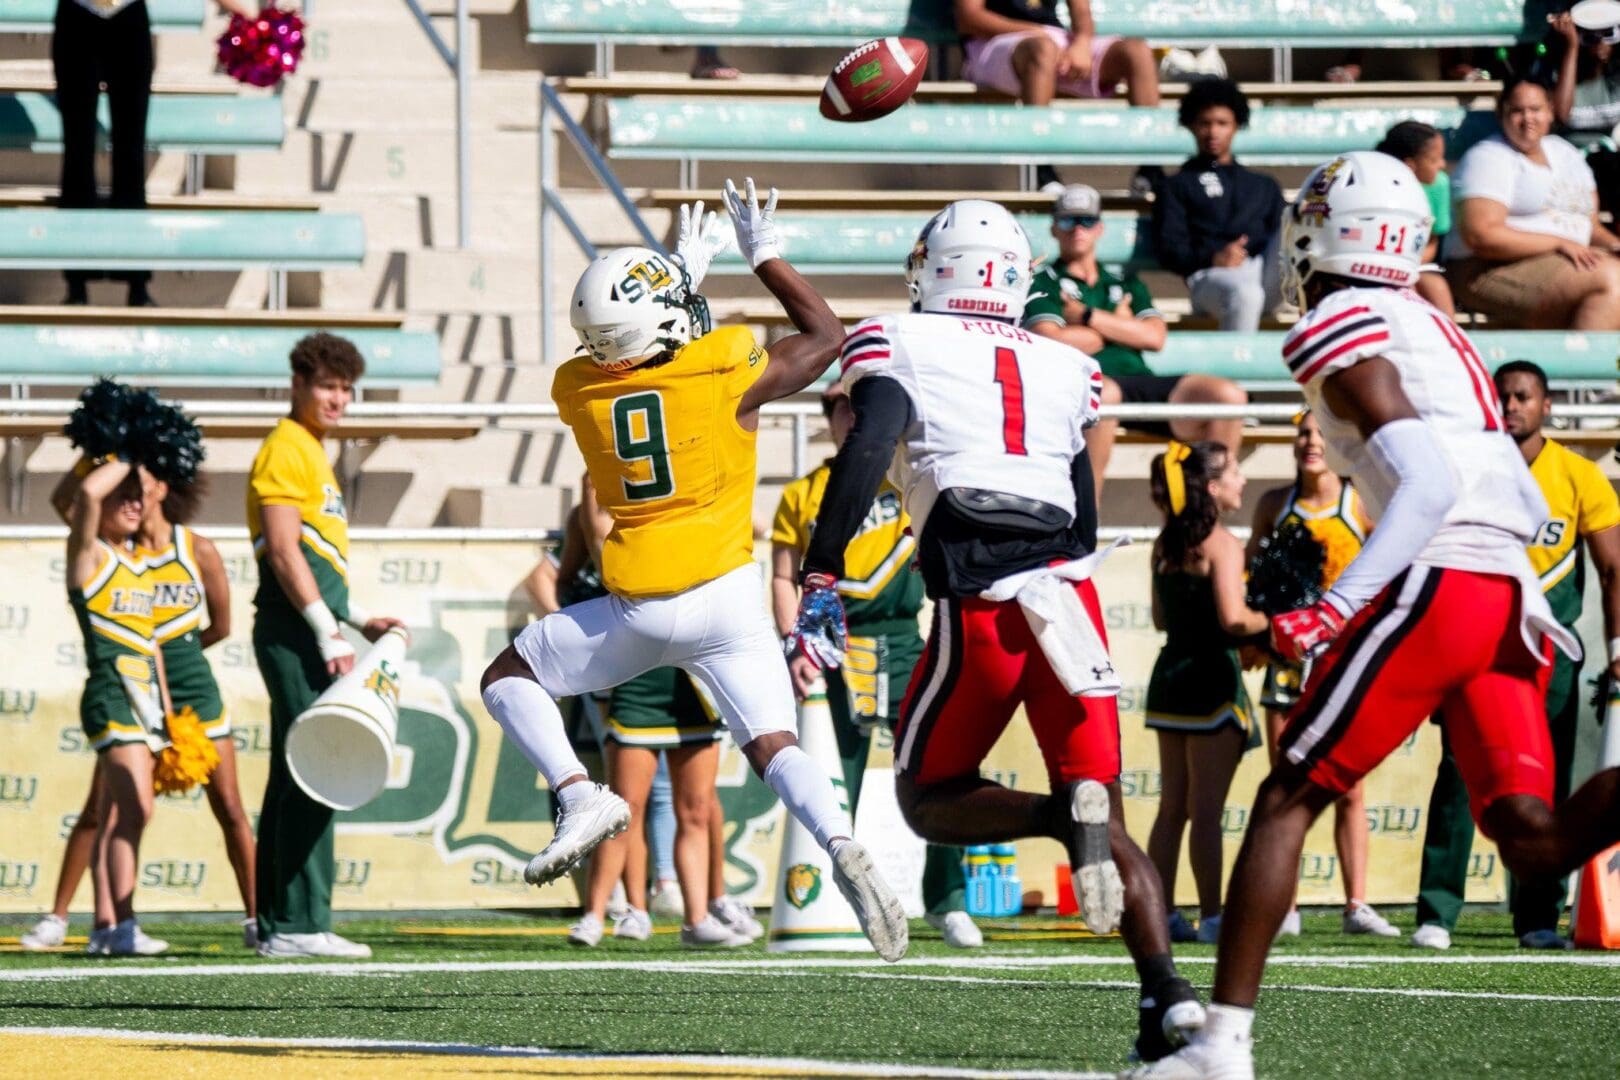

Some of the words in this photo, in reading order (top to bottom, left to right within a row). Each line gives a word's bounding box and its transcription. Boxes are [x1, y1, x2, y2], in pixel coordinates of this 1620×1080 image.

[386, 147, 405, 177] 5
[983, 261, 994, 288] 1
[947, 297, 1008, 315] CARDINALS
[748, 344, 768, 368] SL
[993, 345, 1029, 456] 1
[611, 389, 676, 502] 9
[380, 557, 442, 586] SLU
[0, 775, 38, 802] LU
[0, 861, 39, 889] LU
[142, 860, 206, 890] SLU
